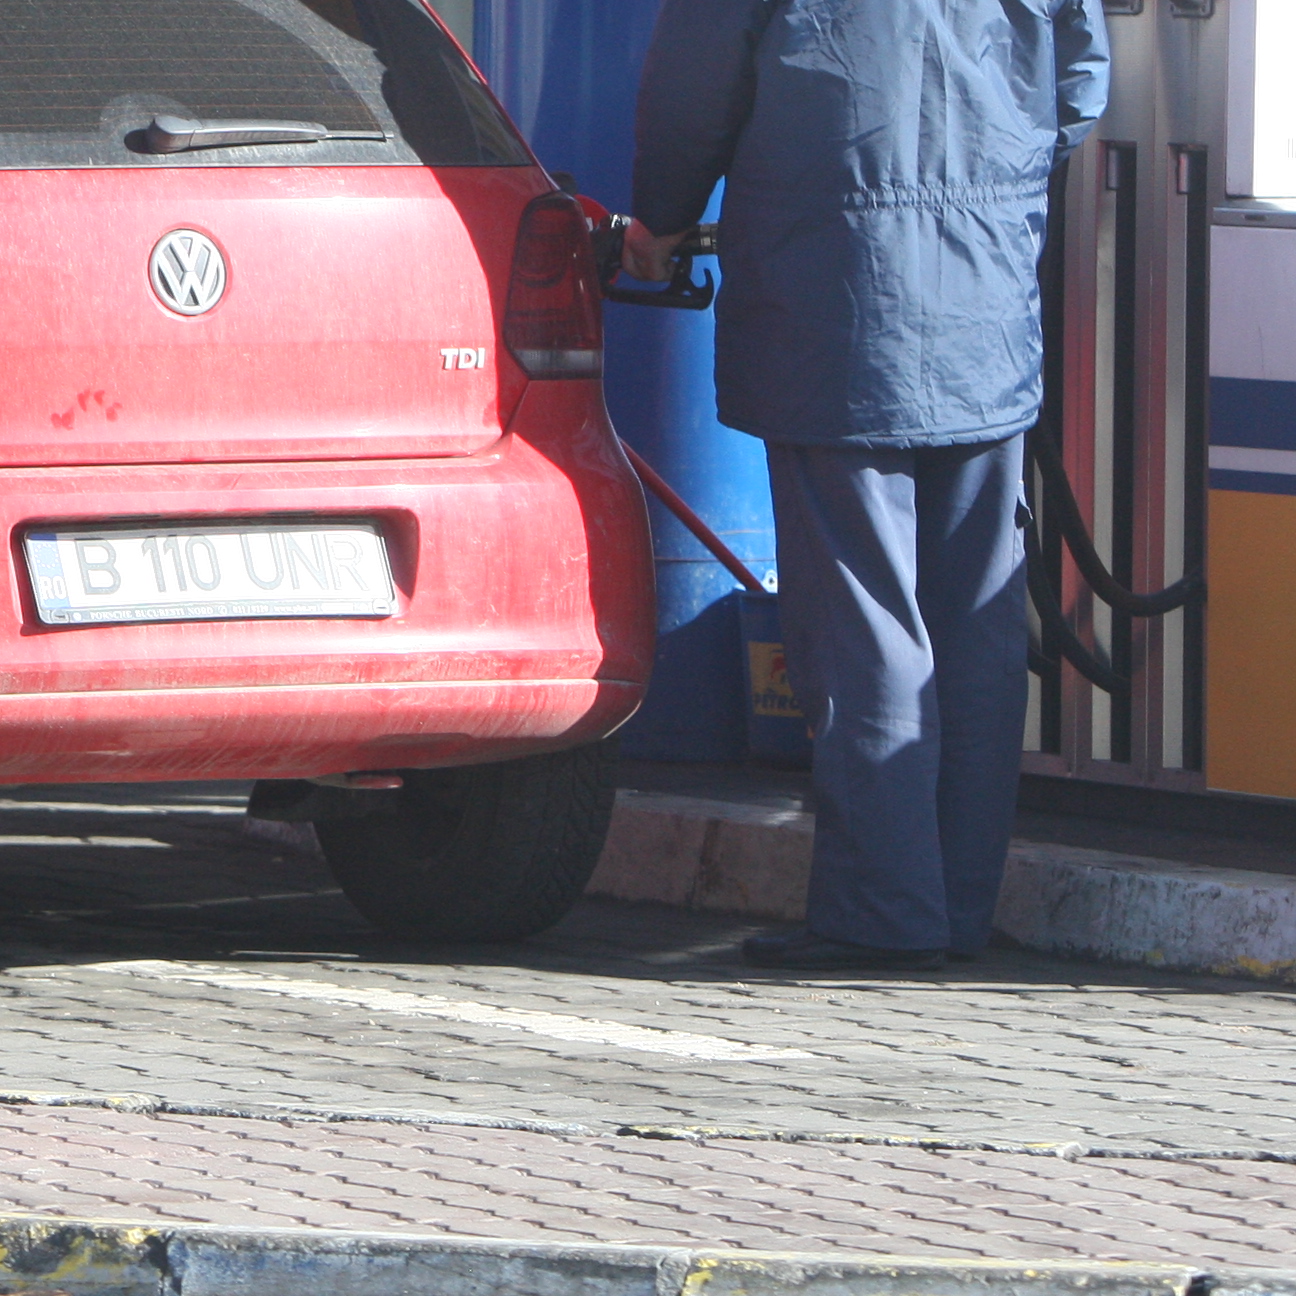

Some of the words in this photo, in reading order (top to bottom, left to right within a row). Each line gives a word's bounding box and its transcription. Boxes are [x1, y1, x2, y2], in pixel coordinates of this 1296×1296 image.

[440, 347, 486, 371] TDI
[74, 537, 122, 596] B
[141, 535, 222, 594] 110
[238, 531, 371, 592] UNR
[39, 575, 68, 601] RO
[89, 610, 133, 621] PORSCHE
[187, 606, 214, 617] NORD
